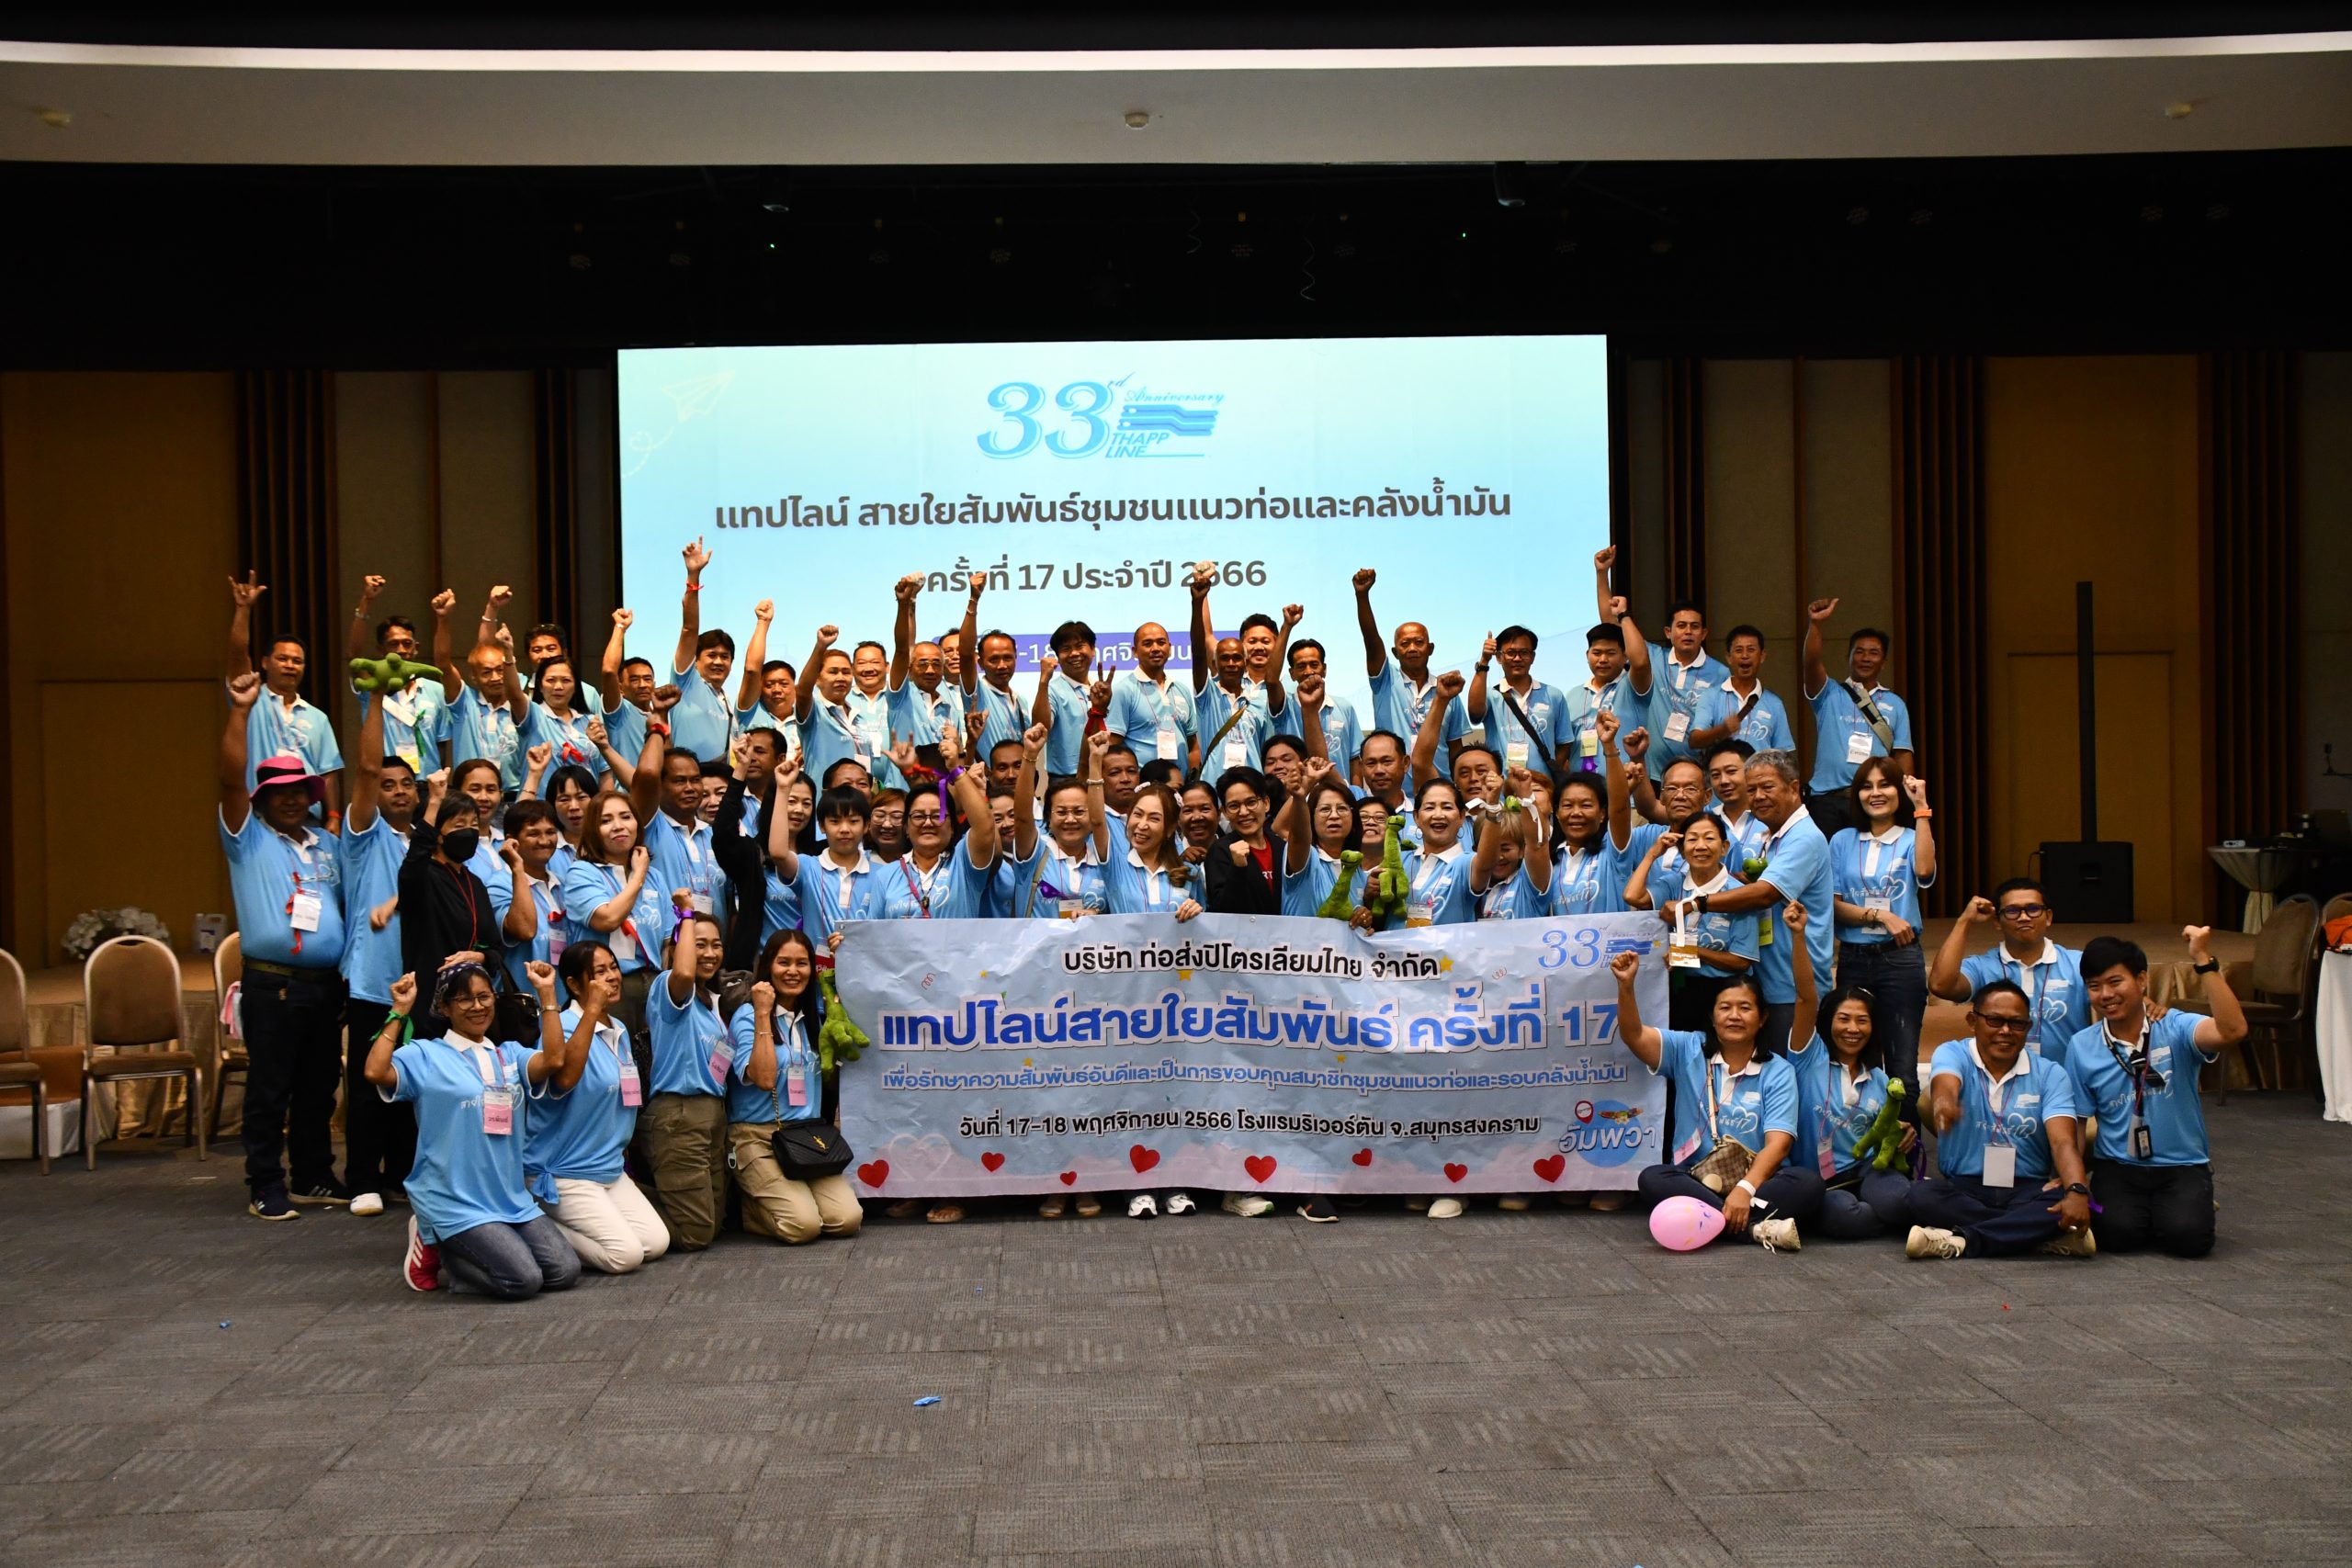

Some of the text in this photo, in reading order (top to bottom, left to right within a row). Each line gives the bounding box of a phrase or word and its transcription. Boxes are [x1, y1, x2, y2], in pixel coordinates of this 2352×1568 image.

[1125, 387, 1225, 408] Anniversary
[977, 380, 1114, 459] 33
[1105, 446, 1148, 458] LINE
[1111, 433, 1170, 446] THAPP
[716, 495, 849, 529] แทปไลน์
[927, 553, 1010, 592] ครั้ที่
[1018, 564, 1055, 591] 17
[1062, 559, 1172, 590] ประจำปี
[1065, 939, 1438, 978] บริษัท ท่อส่งปิโตรเลียมไทย จำกัด
[1538, 928, 1601, 969] 33
[883, 984, 1619, 1047] แทปไลน์สายใยสัมพันธ์ ครั้งที่ 17
[961, 1109, 1000, 1135] วันที่
[1073, 1111, 1179, 1136] พฤศจิกายน
[1185, 1110, 1232, 1130] 2566
[1237, 1109, 1384, 1136] โรงแรมริเวอร์ตัน
[1391, 1117, 1539, 1141] จ.สมุทรสงคราม
[1559, 1124, 1657, 1153] อัมพวา
